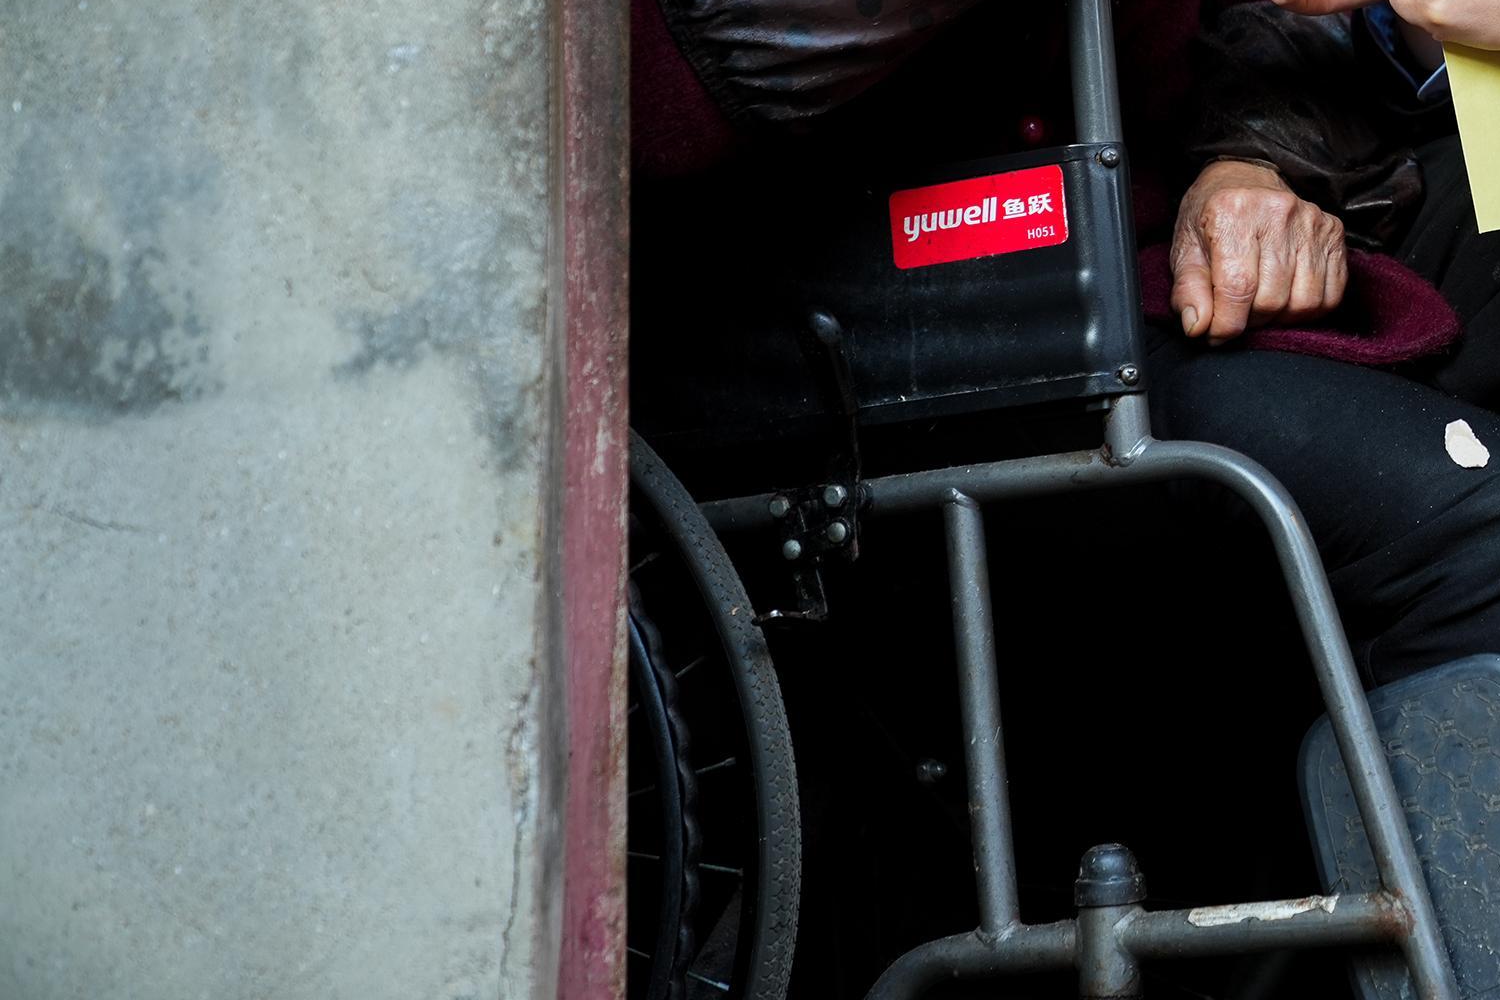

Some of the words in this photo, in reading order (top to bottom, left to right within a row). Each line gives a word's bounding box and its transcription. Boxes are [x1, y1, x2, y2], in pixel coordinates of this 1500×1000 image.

[903, 196, 997, 243] yuwell
[1002, 193, 1053, 220] 鱼跃
[1027, 225, 1056, 240] H051
